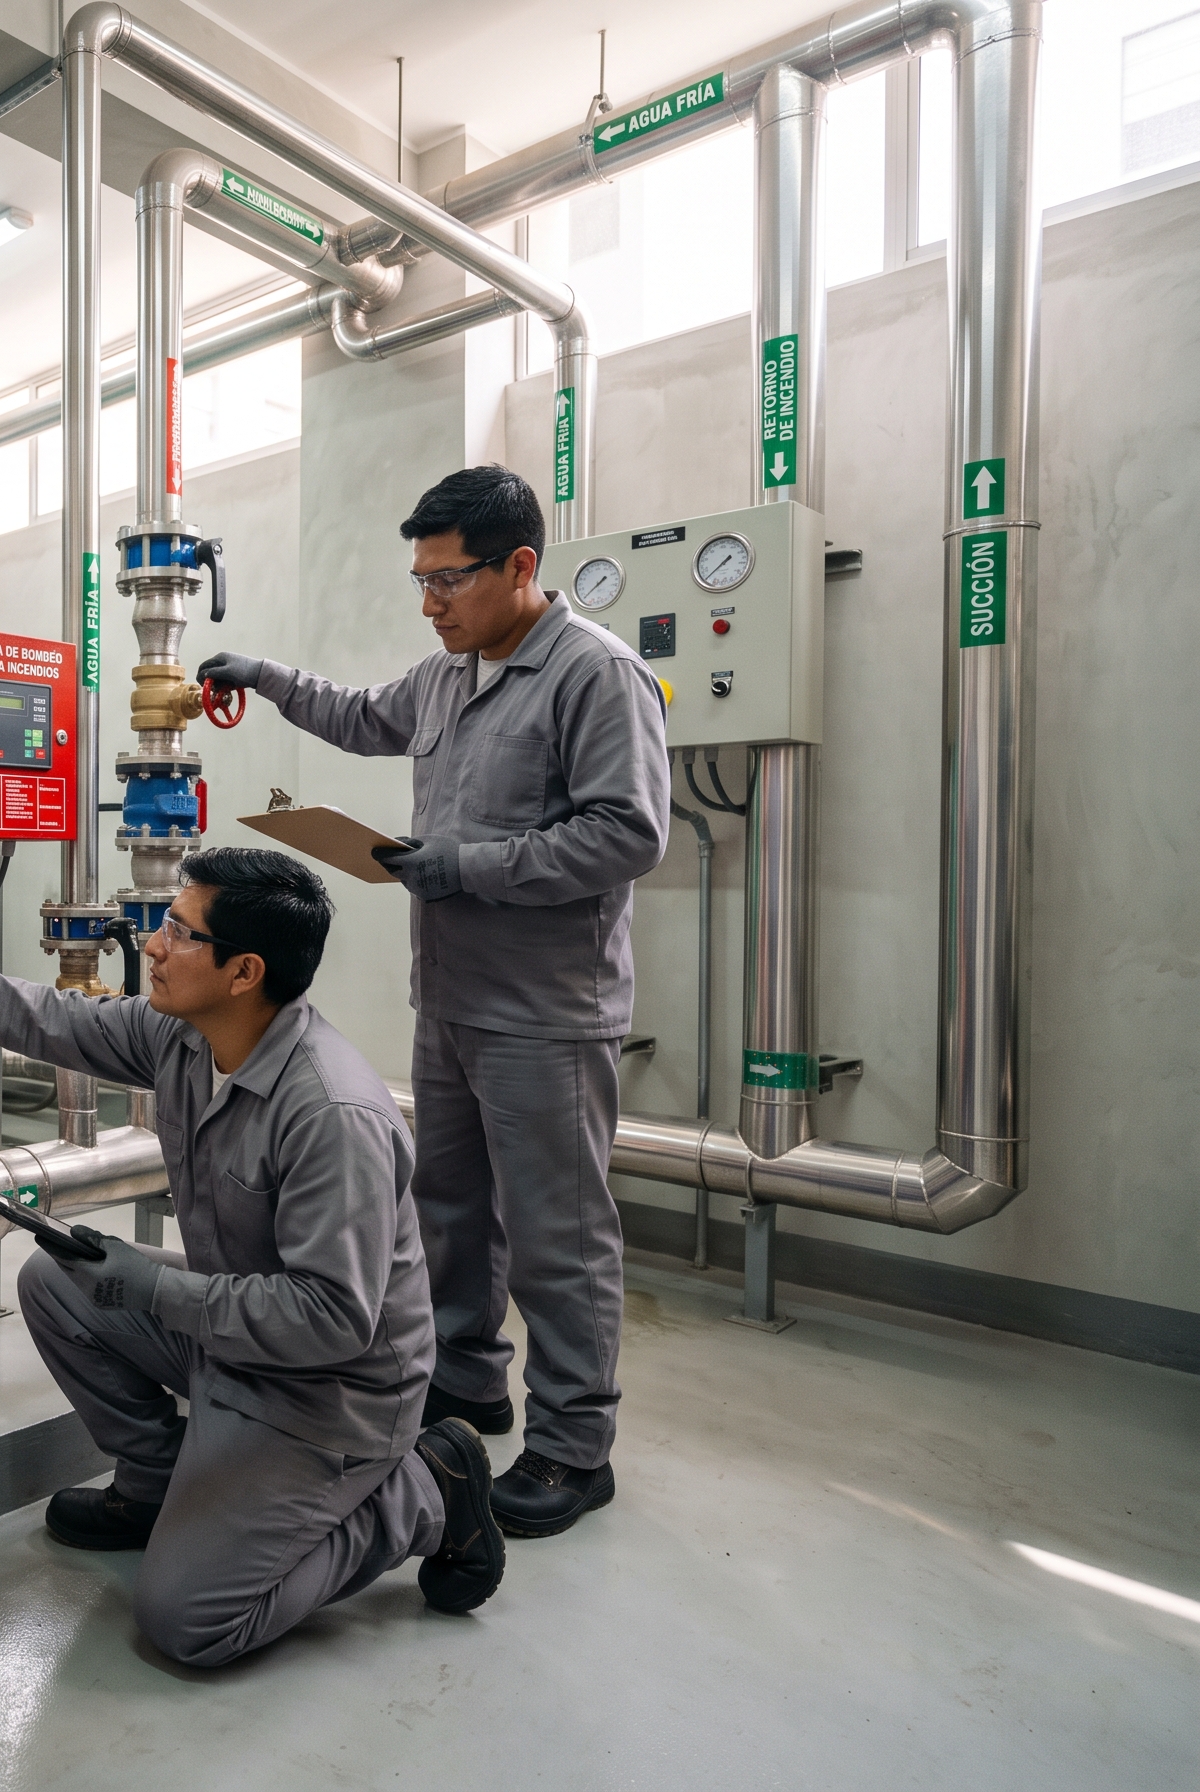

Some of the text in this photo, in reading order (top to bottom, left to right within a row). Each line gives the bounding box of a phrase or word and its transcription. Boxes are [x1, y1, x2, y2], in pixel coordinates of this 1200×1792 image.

[628, 82, 716, 133] AGUA FRÍA
[763, 360, 778, 440] RETORNO
[779, 340, 795, 441] DE INCENDIO
[557, 453, 570, 496] AGUA
[965, 541, 995, 636] SUCCIÓN
[5, 645, 19, 658] DE
[84, 589, 99, 684] AGUA FRÍA
[7, 661, 59, 679] INCENDIOS
